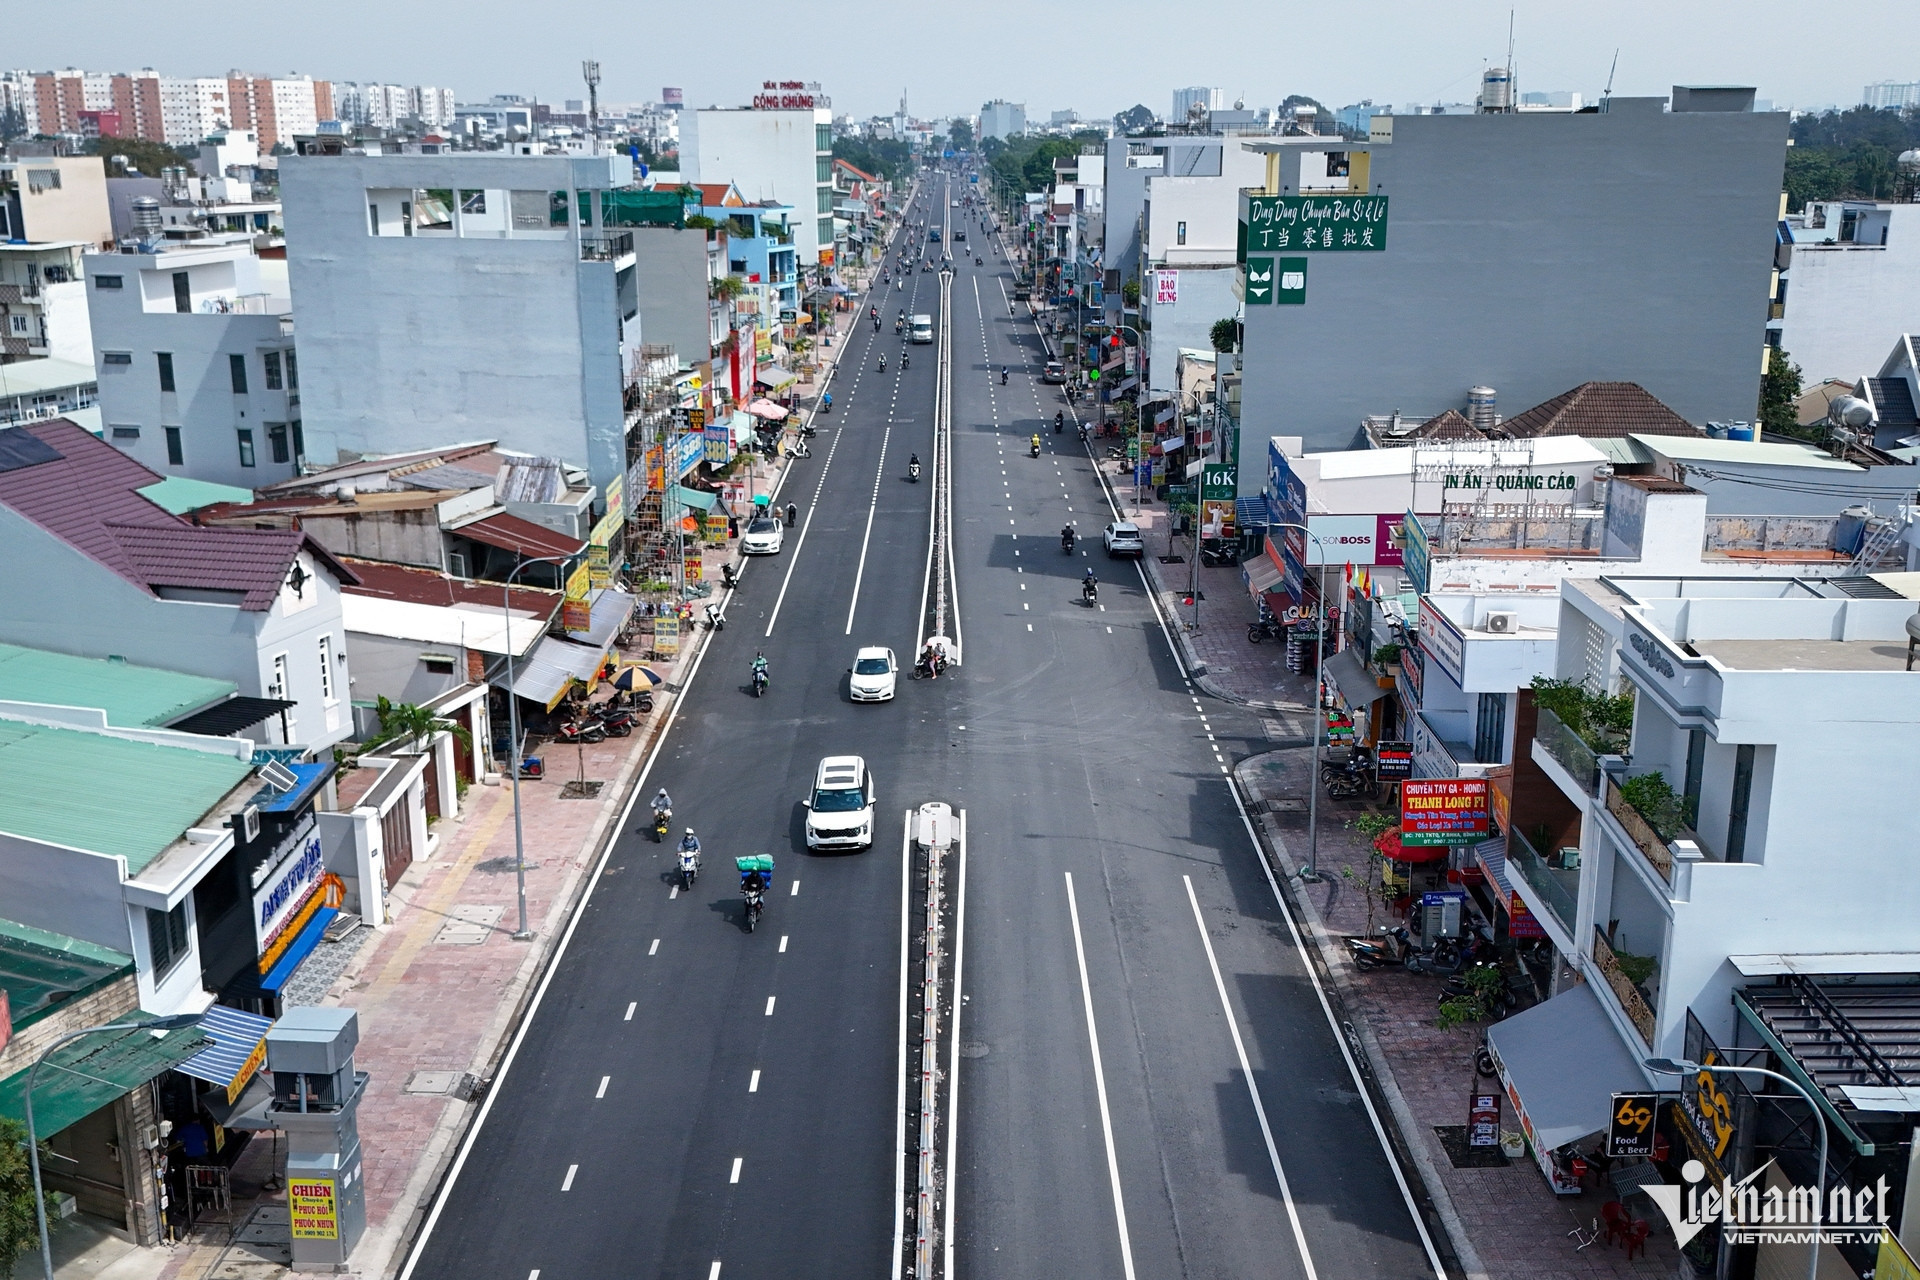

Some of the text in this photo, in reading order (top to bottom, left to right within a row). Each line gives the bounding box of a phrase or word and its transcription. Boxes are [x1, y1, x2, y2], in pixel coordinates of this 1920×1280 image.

[753, 93, 779, 108] CÔNG
[782, 93, 814, 108] CHỨNG
[1275, 199, 1298, 226] Dang
[1301, 200, 1331, 227] Chuyên
[1333, 199, 1350, 222] Bán
[1365, 202, 1373, 223] &
[1259, 227, 1375, 248] 丁当 零售 批发
[705, 440, 727, 462] 388
[1205, 471, 1236, 486] 16K
[1446, 475, 1459, 489] IN
[1463, 470, 1482, 489] ẤN
[1496, 469, 1544, 492] QUẢNG
[1547, 469, 1576, 489] CÁO
[738, 492, 743, 500] Y
[1323, 536, 1371, 545] SONBOSS
[1406, 782, 1433, 794] CHUYÊN
[1434, 784, 1447, 794] TAY
[1449, 784, 1457, 793] GA
[1464, 784, 1486, 793] HONDA
[1408, 796, 1484, 809] THANH LONG FI
[1616, 1099, 1653, 1133] 69
[1682, 1092, 1696, 1120] Food
[1701, 1121, 1716, 1150] Beer
[292, 1183, 331, 1197] CHIẾN
